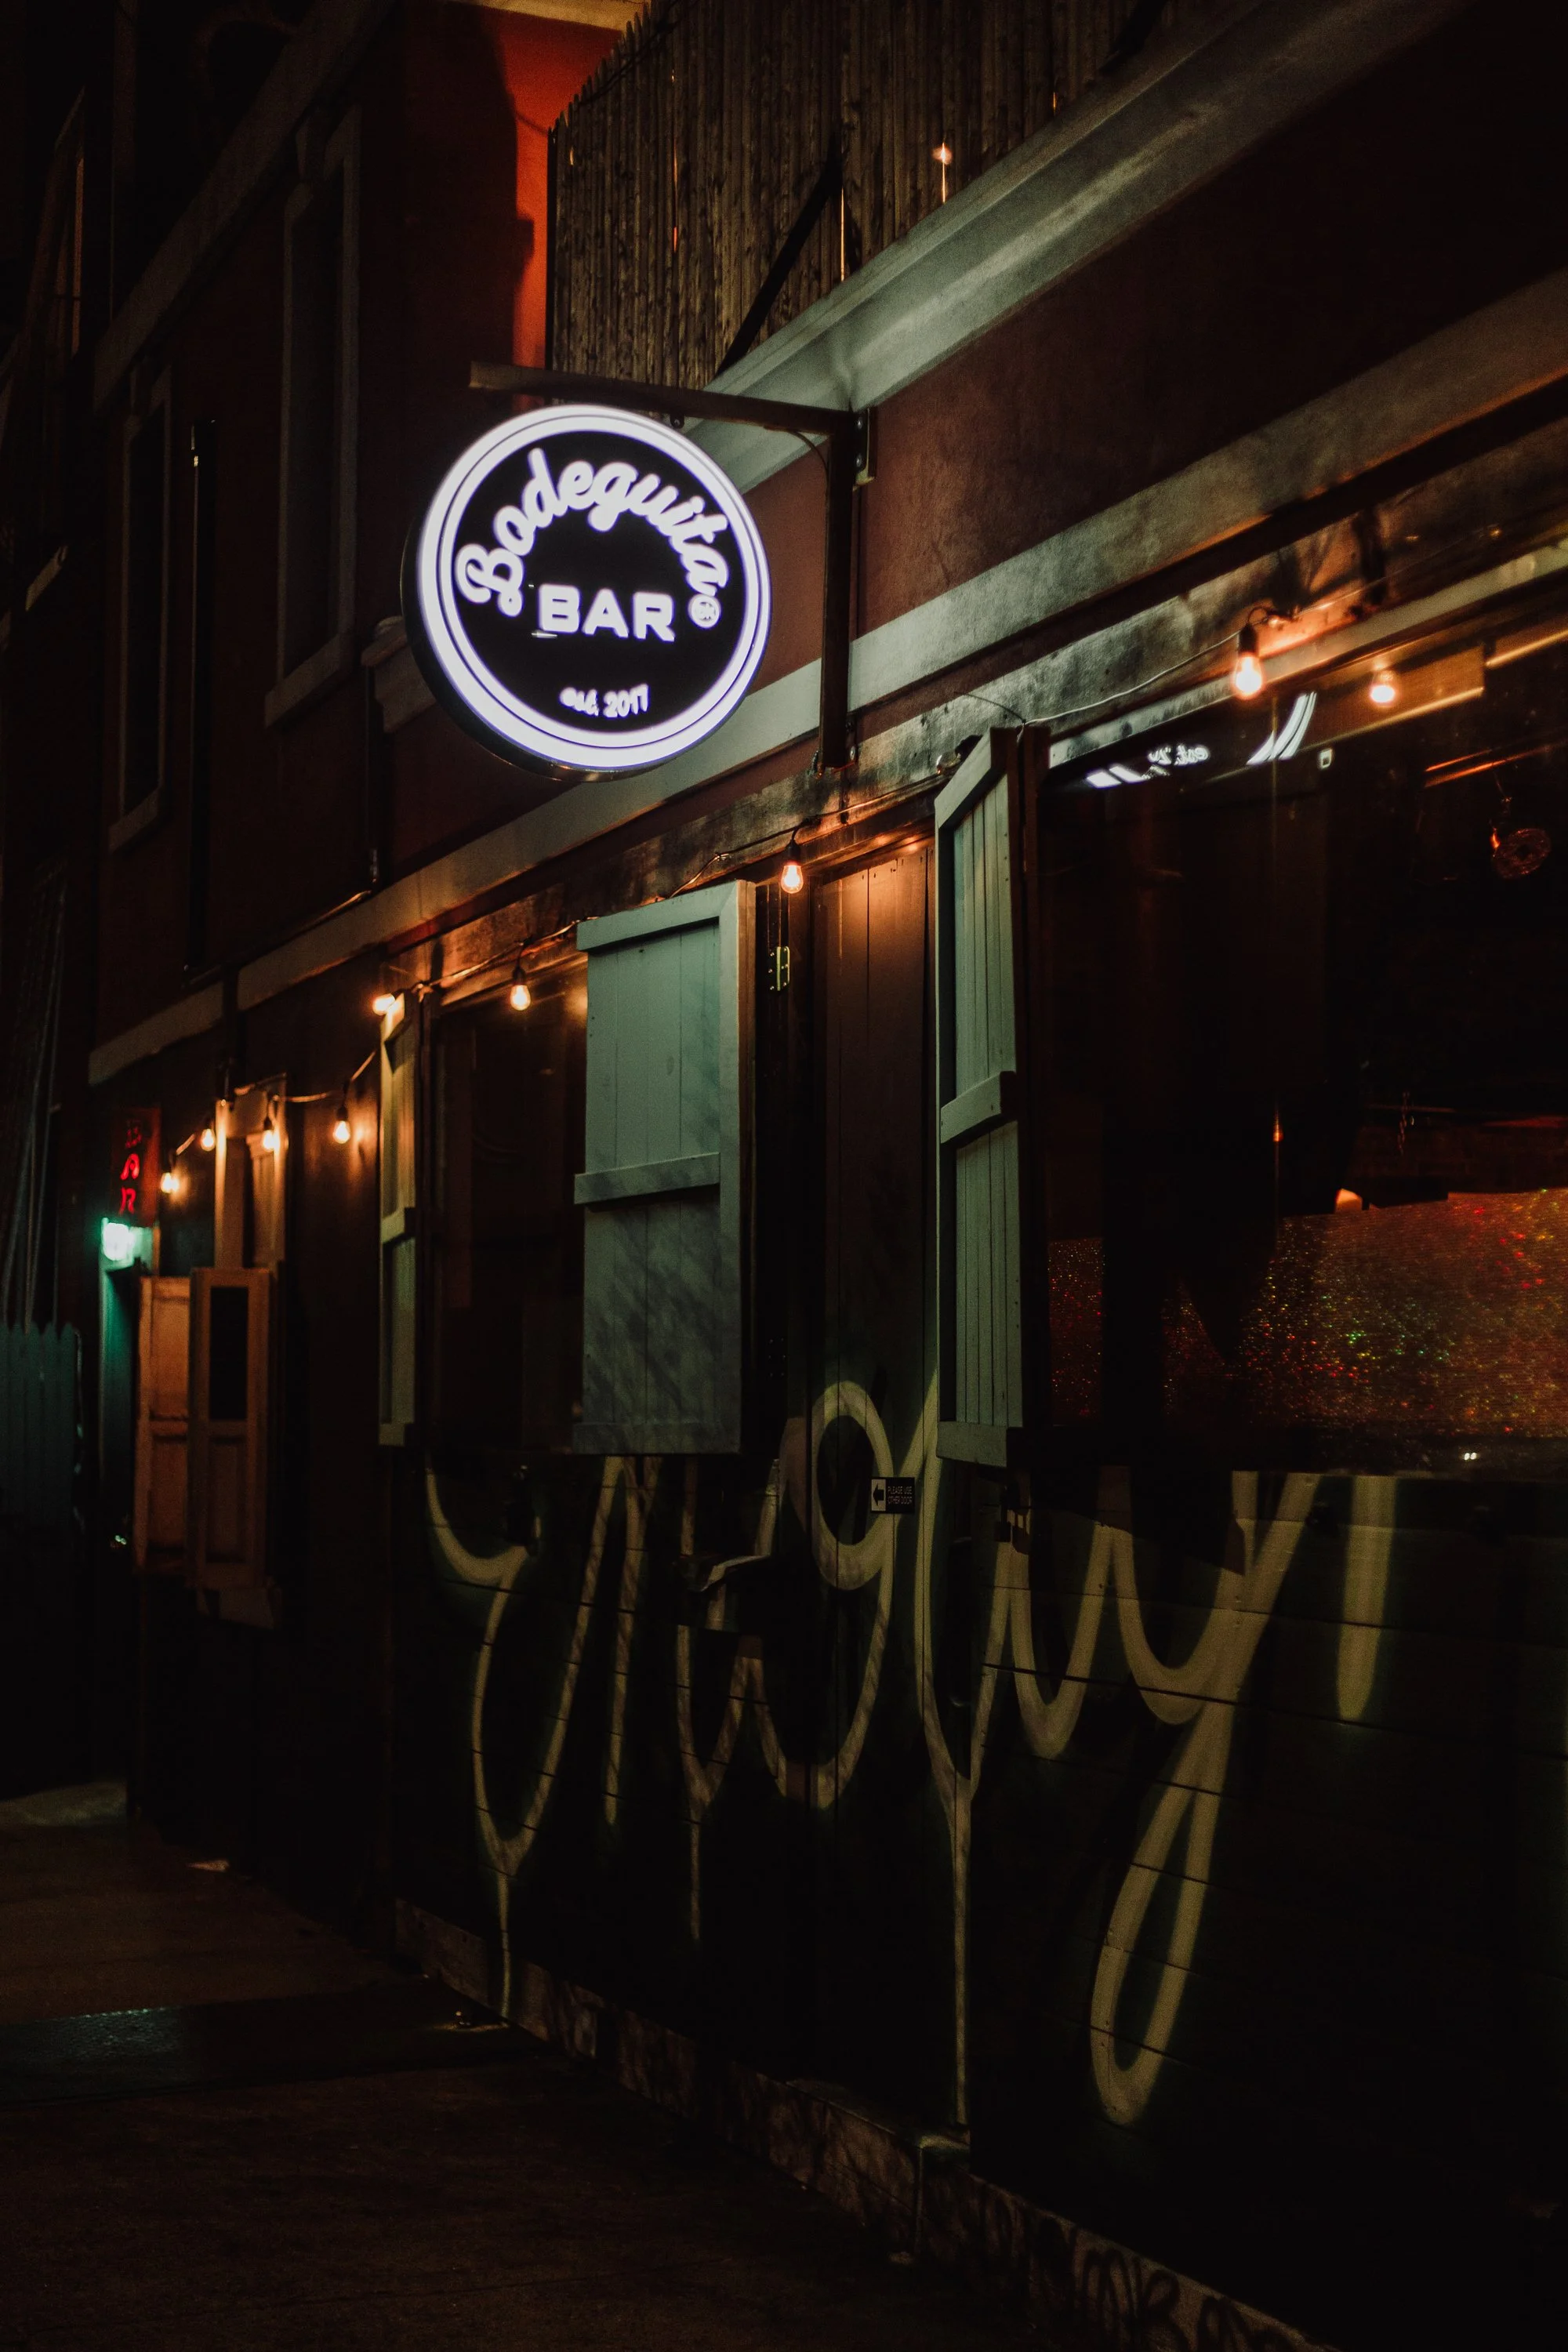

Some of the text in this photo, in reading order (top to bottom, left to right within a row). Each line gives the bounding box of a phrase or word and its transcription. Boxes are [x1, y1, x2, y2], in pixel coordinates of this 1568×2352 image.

[455, 448, 729, 617] Bodeguita
[538, 583, 675, 642] BAR
[603, 683, 649, 718] 2017
[887, 1486, 913, 1494] PLEASE USE
[887, 1496, 913, 1504] OTHER DOOR
